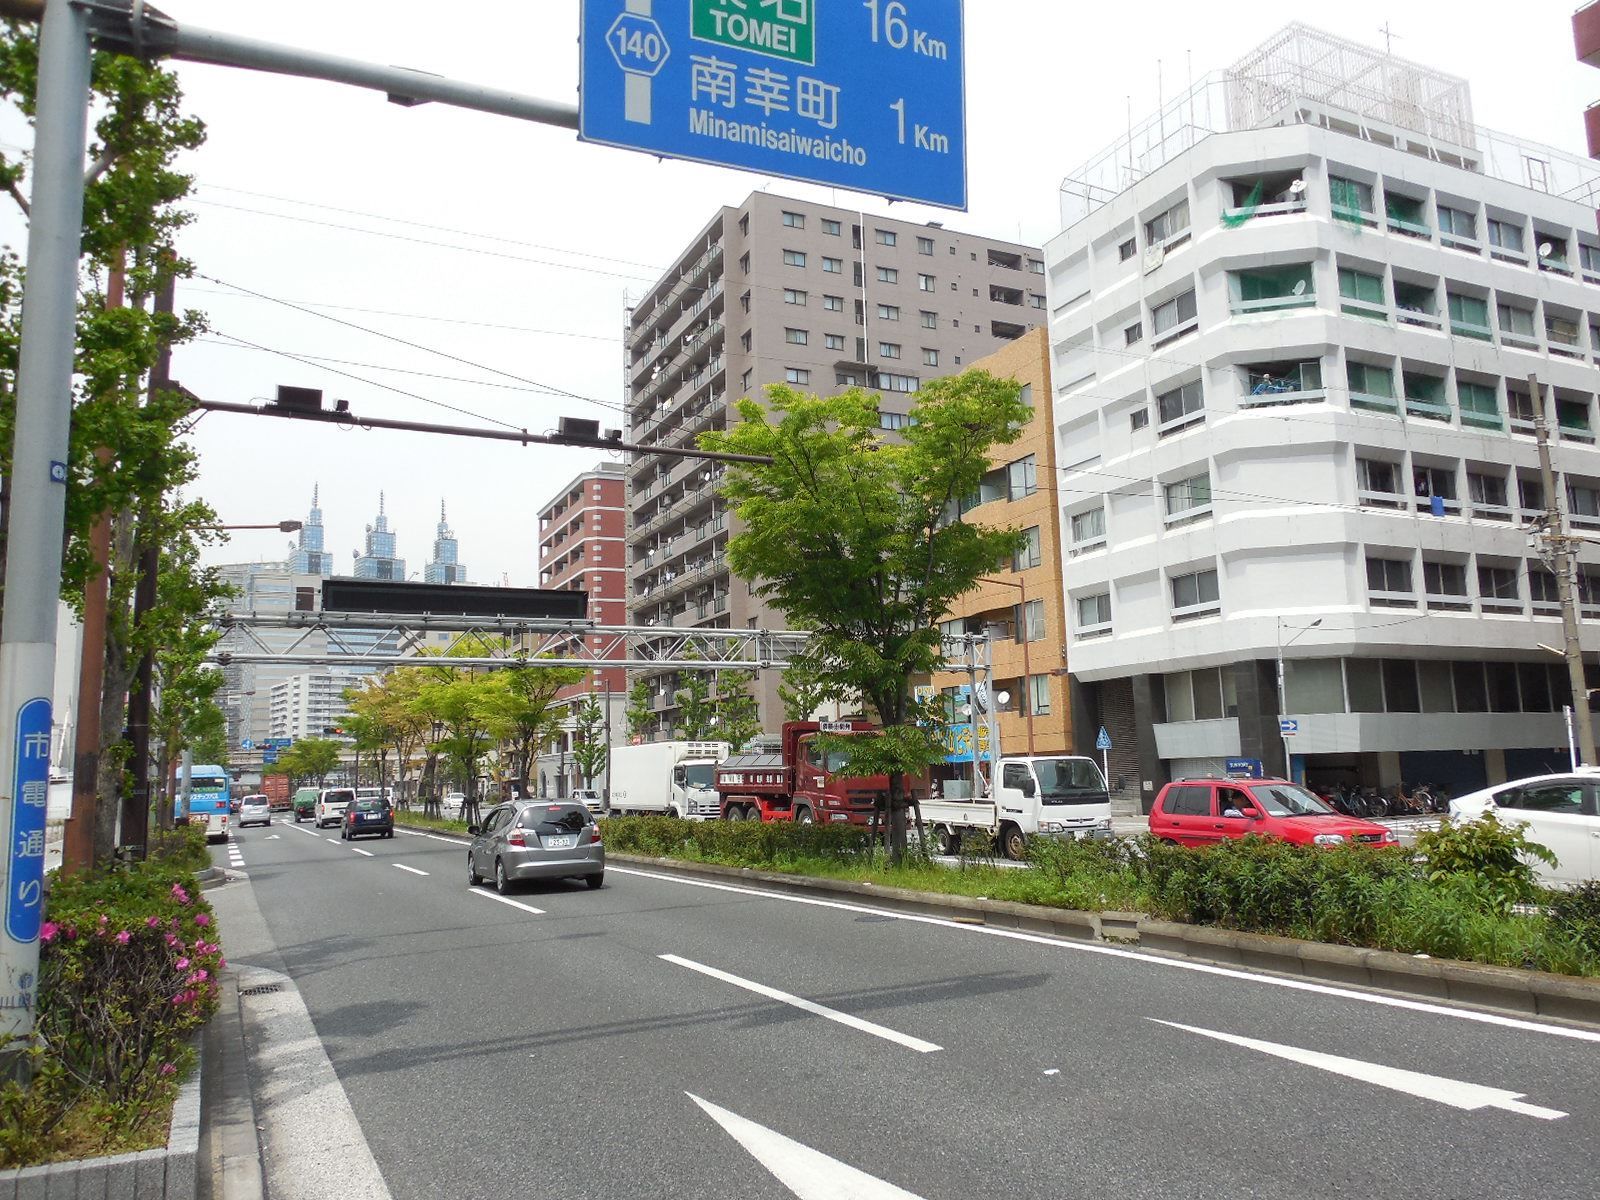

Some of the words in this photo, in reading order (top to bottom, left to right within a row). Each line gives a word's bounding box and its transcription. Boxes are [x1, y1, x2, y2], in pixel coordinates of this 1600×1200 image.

[616, 27, 661, 63] 140
[709, 8, 796, 54] TOMEI
[863, 0, 909, 49] 16
[914, 29, 947, 60] Km
[689, 55, 841, 130] 南幸町
[689, 107, 867, 167] Minamisaiwaicho
[889, 98, 905, 145] 1
[914, 124, 949, 154] Km
[17, 731, 50, 907] 市電通り
